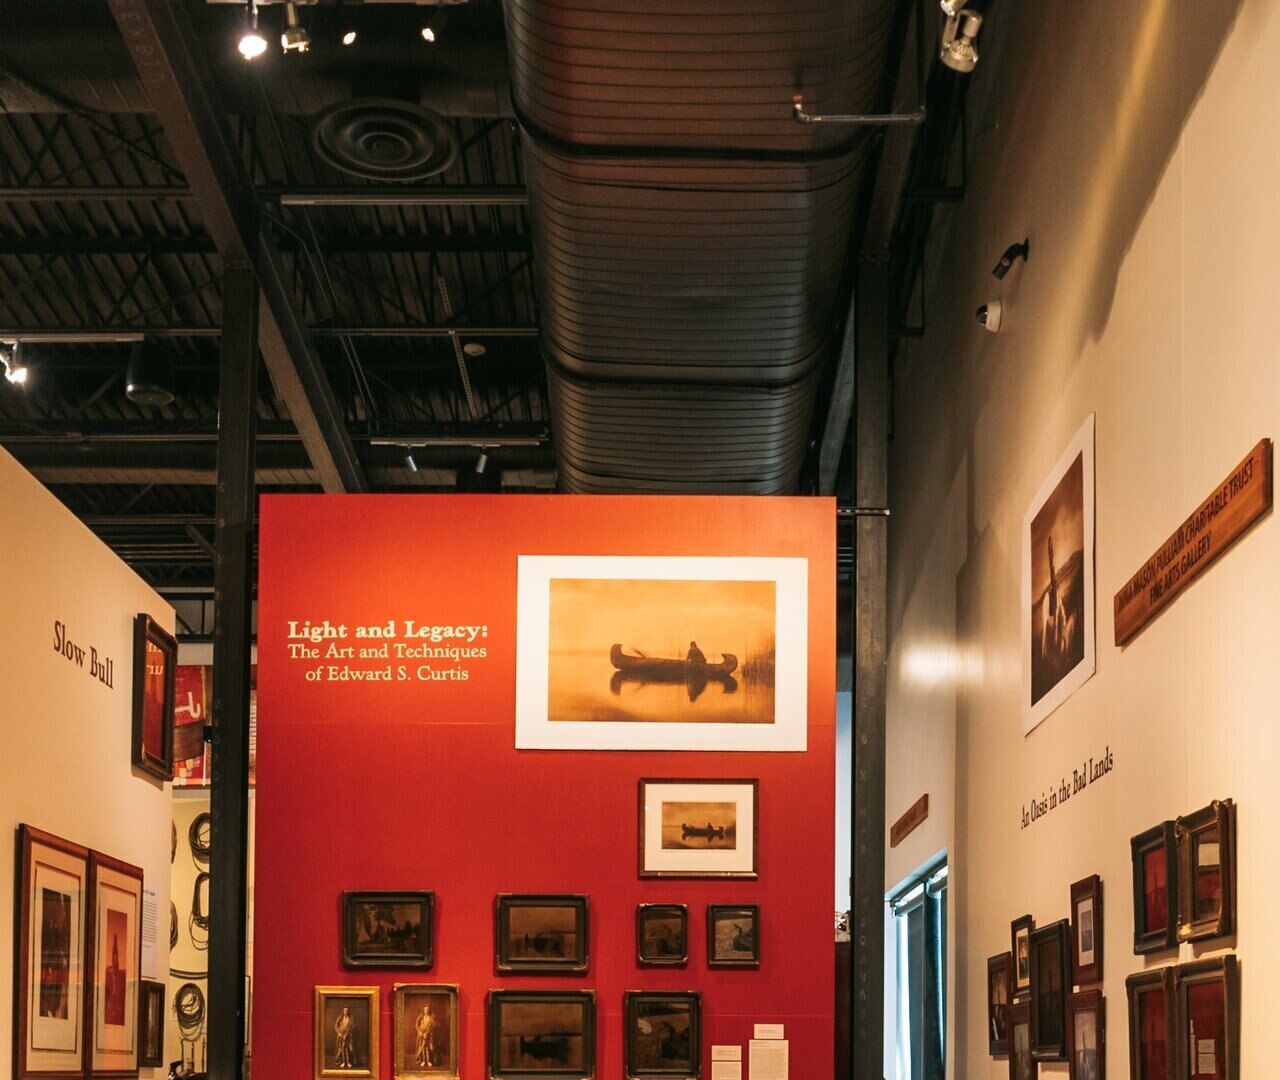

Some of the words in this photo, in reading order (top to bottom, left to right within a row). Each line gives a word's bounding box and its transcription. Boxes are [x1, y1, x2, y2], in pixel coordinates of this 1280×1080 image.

[1133, 563, 1156, 594] MASON
[1156, 529, 1185, 574] PULLIAM
[1185, 486, 1229, 545] CHARITABLE
[1229, 457, 1253, 499] TRUST
[1149, 583, 1163, 607] FINE
[1163, 562, 1180, 594] ARTS
[1180, 531, 1211, 575] GALLERY
[53, 620, 86, 669] Slow
[90, 646, 114, 689] Bull
[287, 621, 348, 642] Light
[356, 621, 396, 639] and
[404, 621, 488, 642] Legacy:
[288, 643, 322, 659] The
[325, 642, 354, 659] Art
[358, 643, 390, 659] and
[393, 643, 487, 662] Techniques
[305, 665, 324, 681] of
[328, 665, 392, 681] Edward
[397, 666, 412, 681] S.
[416, 665, 469, 681] Curtis
[1021, 806, 1029, 830] An
[1031, 793, 1048, 822] Oasis
[1049, 787, 1056, 810] in
[1059, 778, 1070, 804] the
[1073, 762, 1086, 795] Bad
[1089, 745, 1113, 784] Lands
